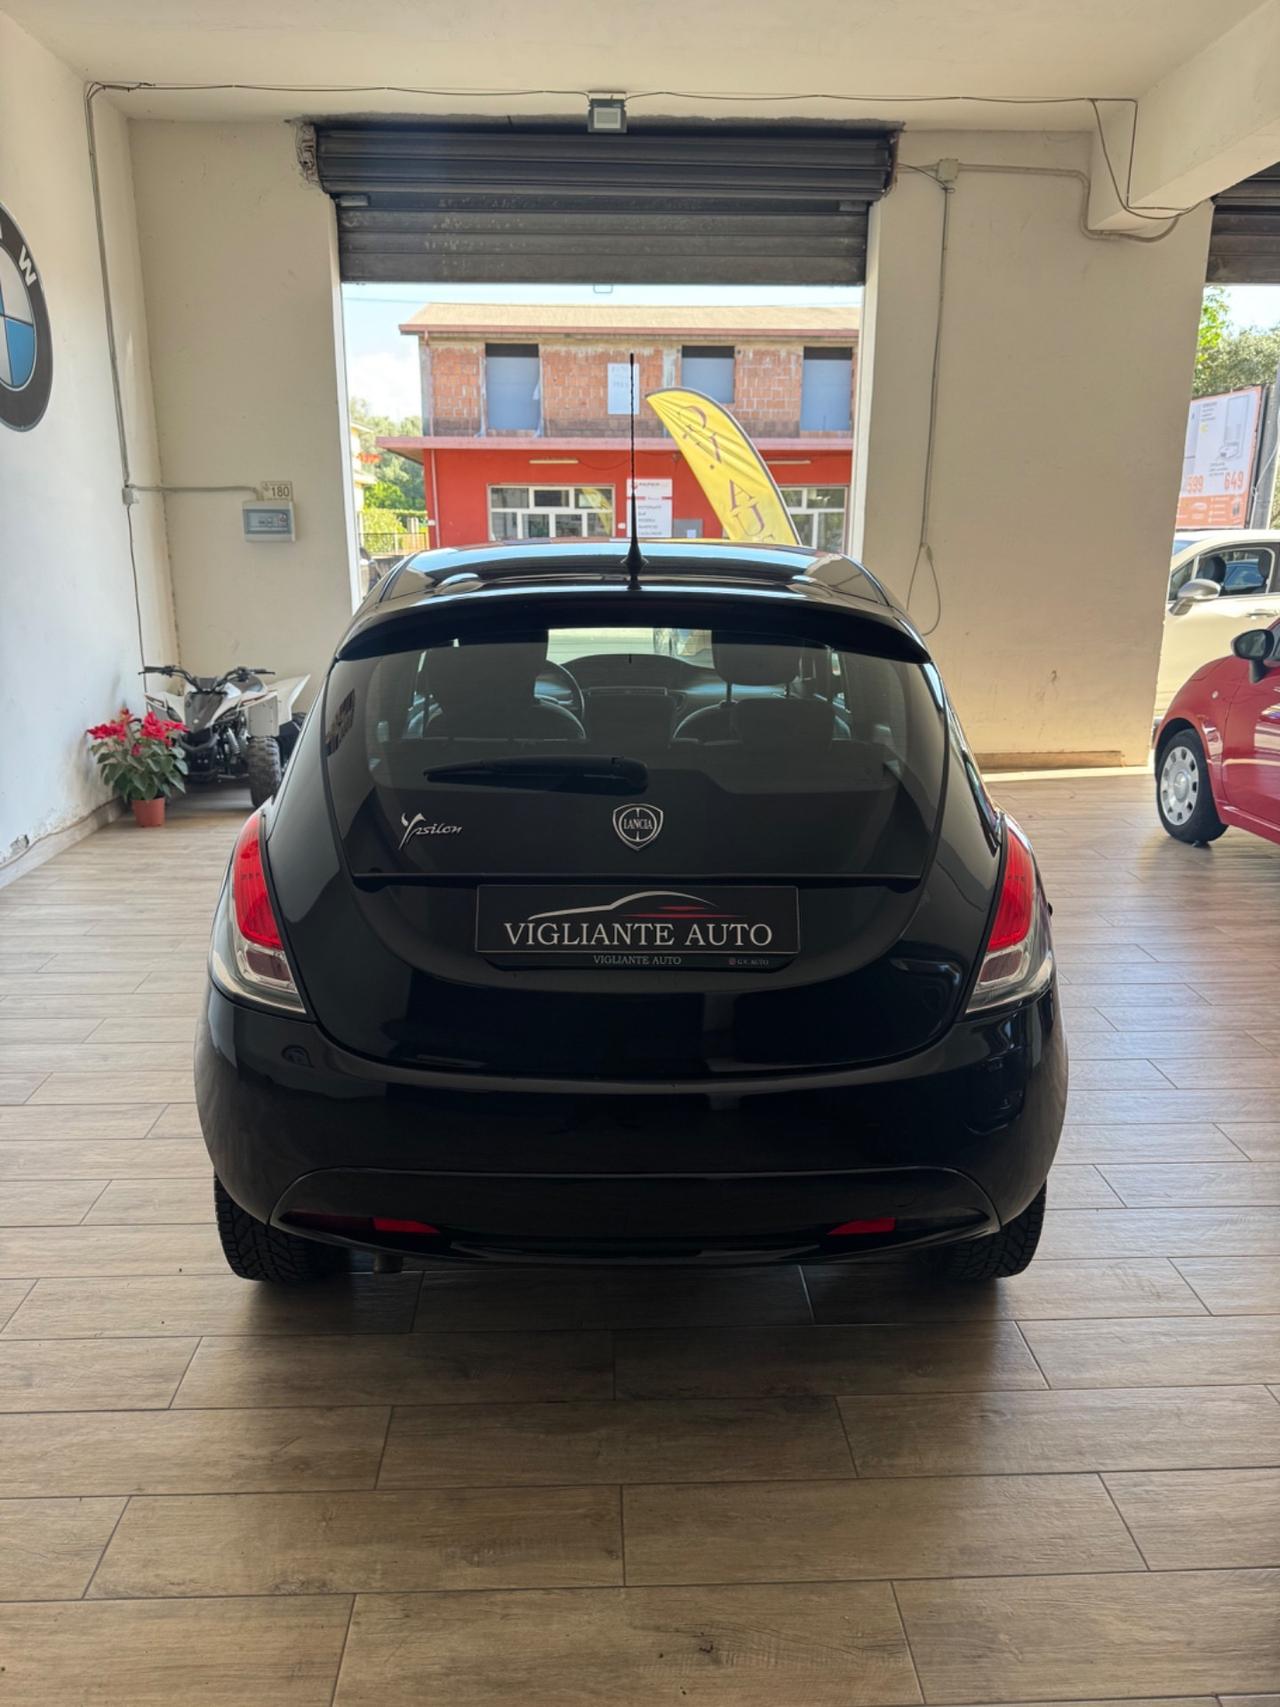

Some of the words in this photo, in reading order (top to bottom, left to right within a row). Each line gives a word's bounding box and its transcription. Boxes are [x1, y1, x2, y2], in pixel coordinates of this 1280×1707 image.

[1224, 471, 1244, 490] 649
[271, 486, 290, 497] 180
[398, 813, 463, 850] Ypsilon
[623, 818, 653, 830] LANCIA
[503, 922, 675, 946] VIGLIANTE
[684, 923, 773, 946] AUTO
[593, 954, 649, 965] VIGLIANTE
[652, 956, 682, 966] AUTO
